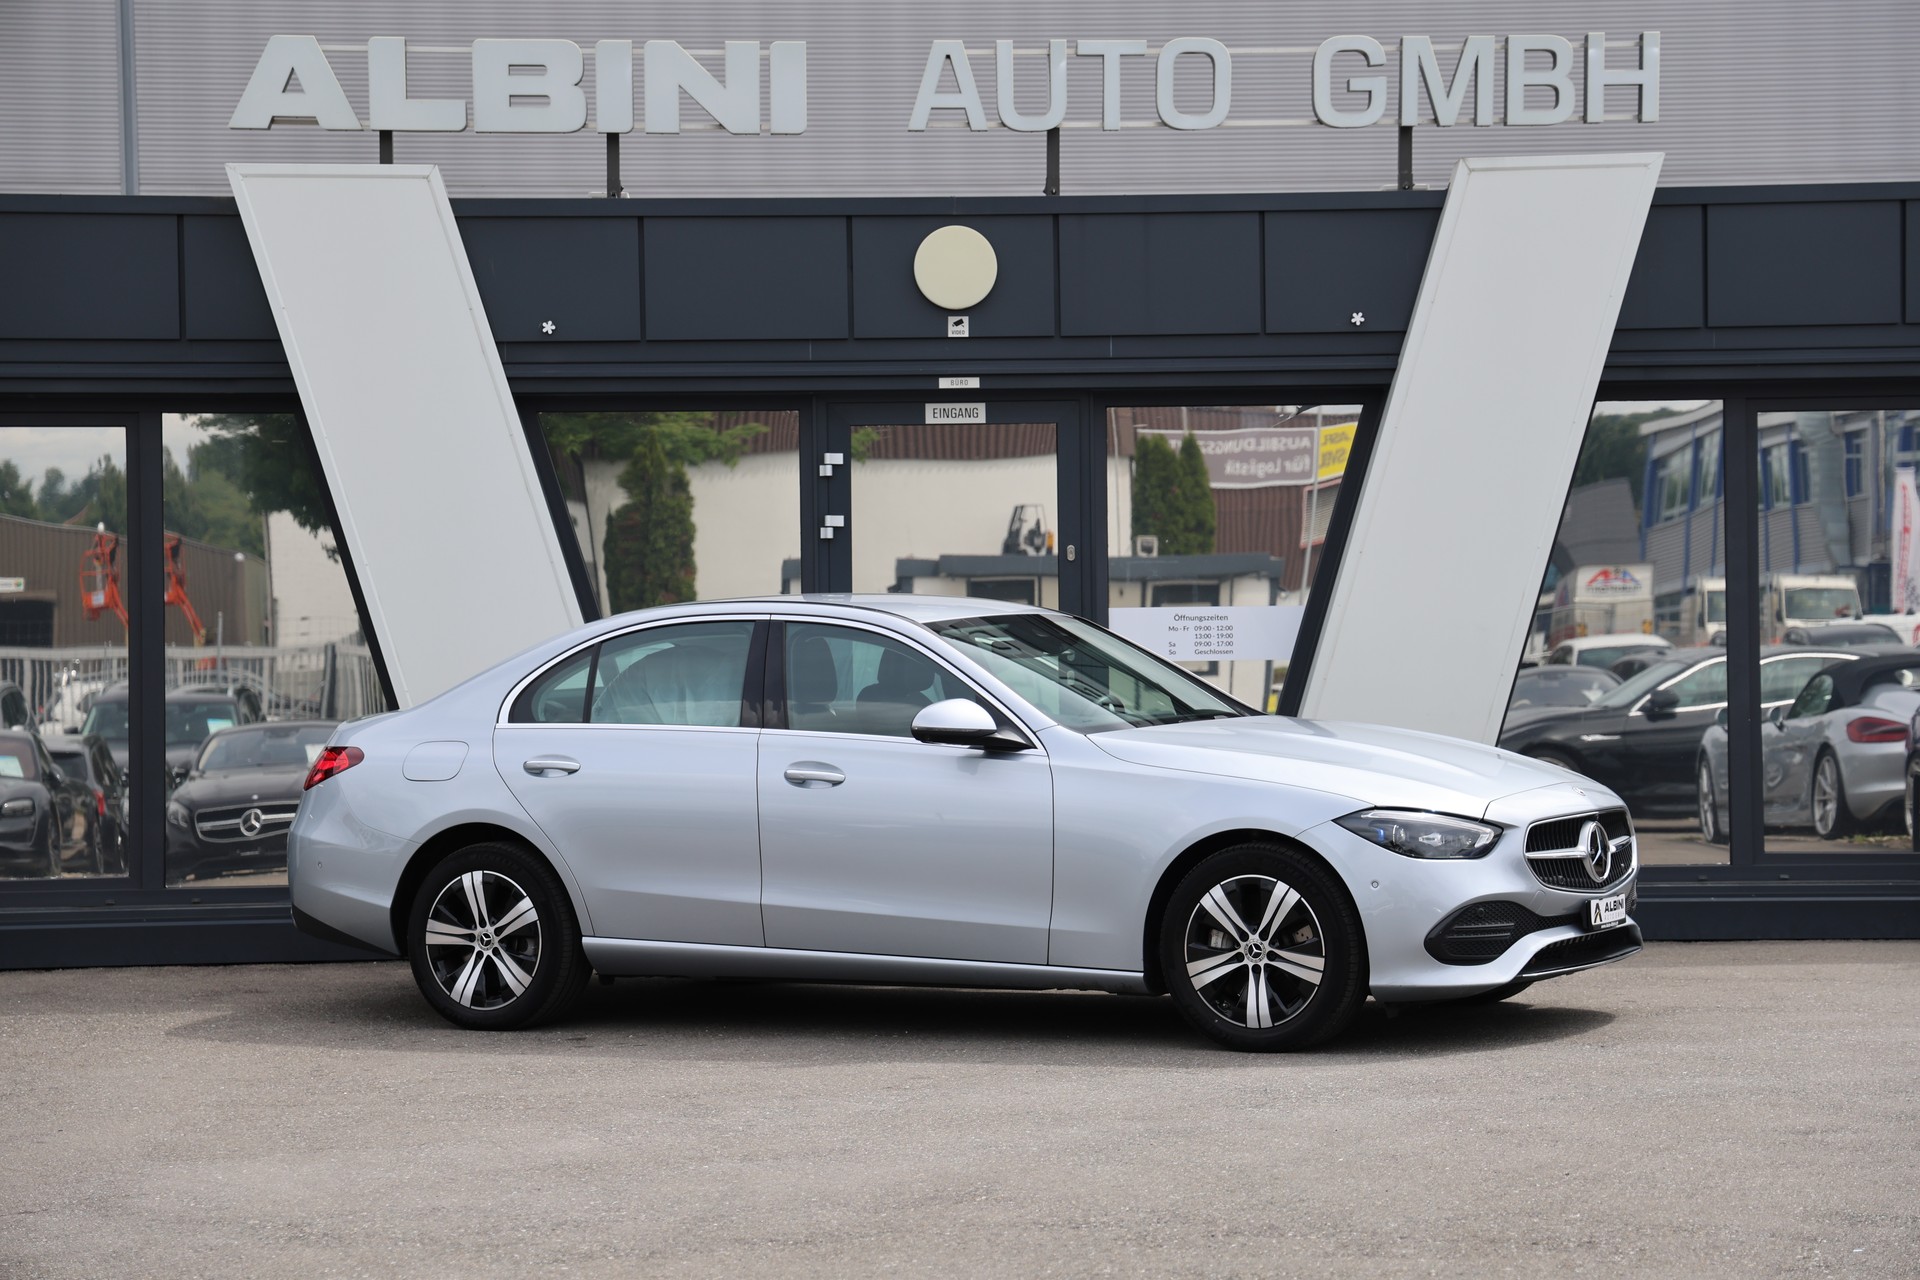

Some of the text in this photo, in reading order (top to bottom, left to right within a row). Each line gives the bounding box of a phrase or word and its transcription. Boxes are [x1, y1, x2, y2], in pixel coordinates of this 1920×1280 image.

[229, 31, 1661, 135] ALBINI AUTO GMBH
[950, 378, 968, 386] BÜRO
[932, 407, 979, 419] EINGANG
[1173, 614, 1229, 622] Öffnungszeiten
